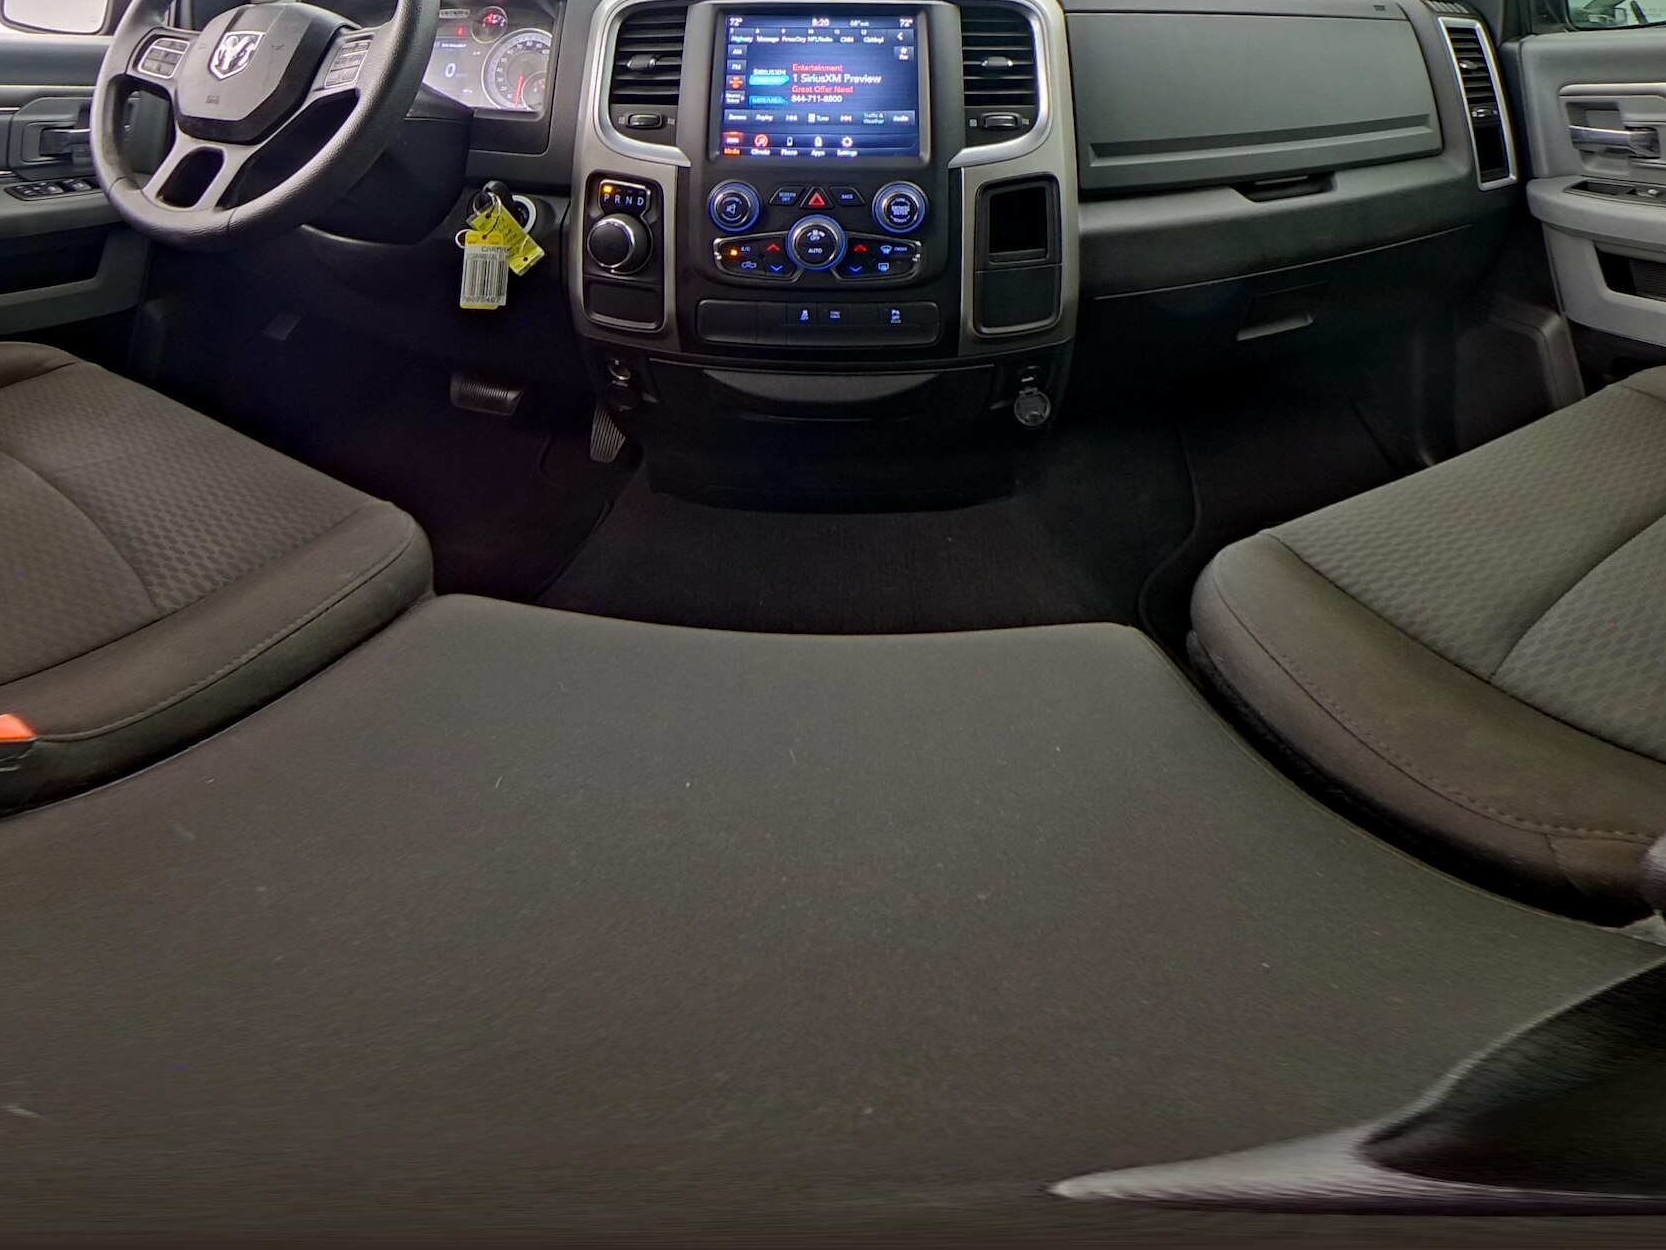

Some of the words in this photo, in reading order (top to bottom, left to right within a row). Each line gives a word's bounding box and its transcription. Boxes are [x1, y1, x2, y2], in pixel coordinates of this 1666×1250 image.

[792, 63, 844, 72] Entertainment
[800, 74, 842, 83] SiriusXM
[844, 74, 881, 83] Preview
[792, 85, 812, 93] Great
[814, 85, 833, 93] Offer
[604, 194, 610, 202] P
[615, 195, 621, 203] R
[625, 196, 633, 205] N
[637, 197, 645, 206] D
